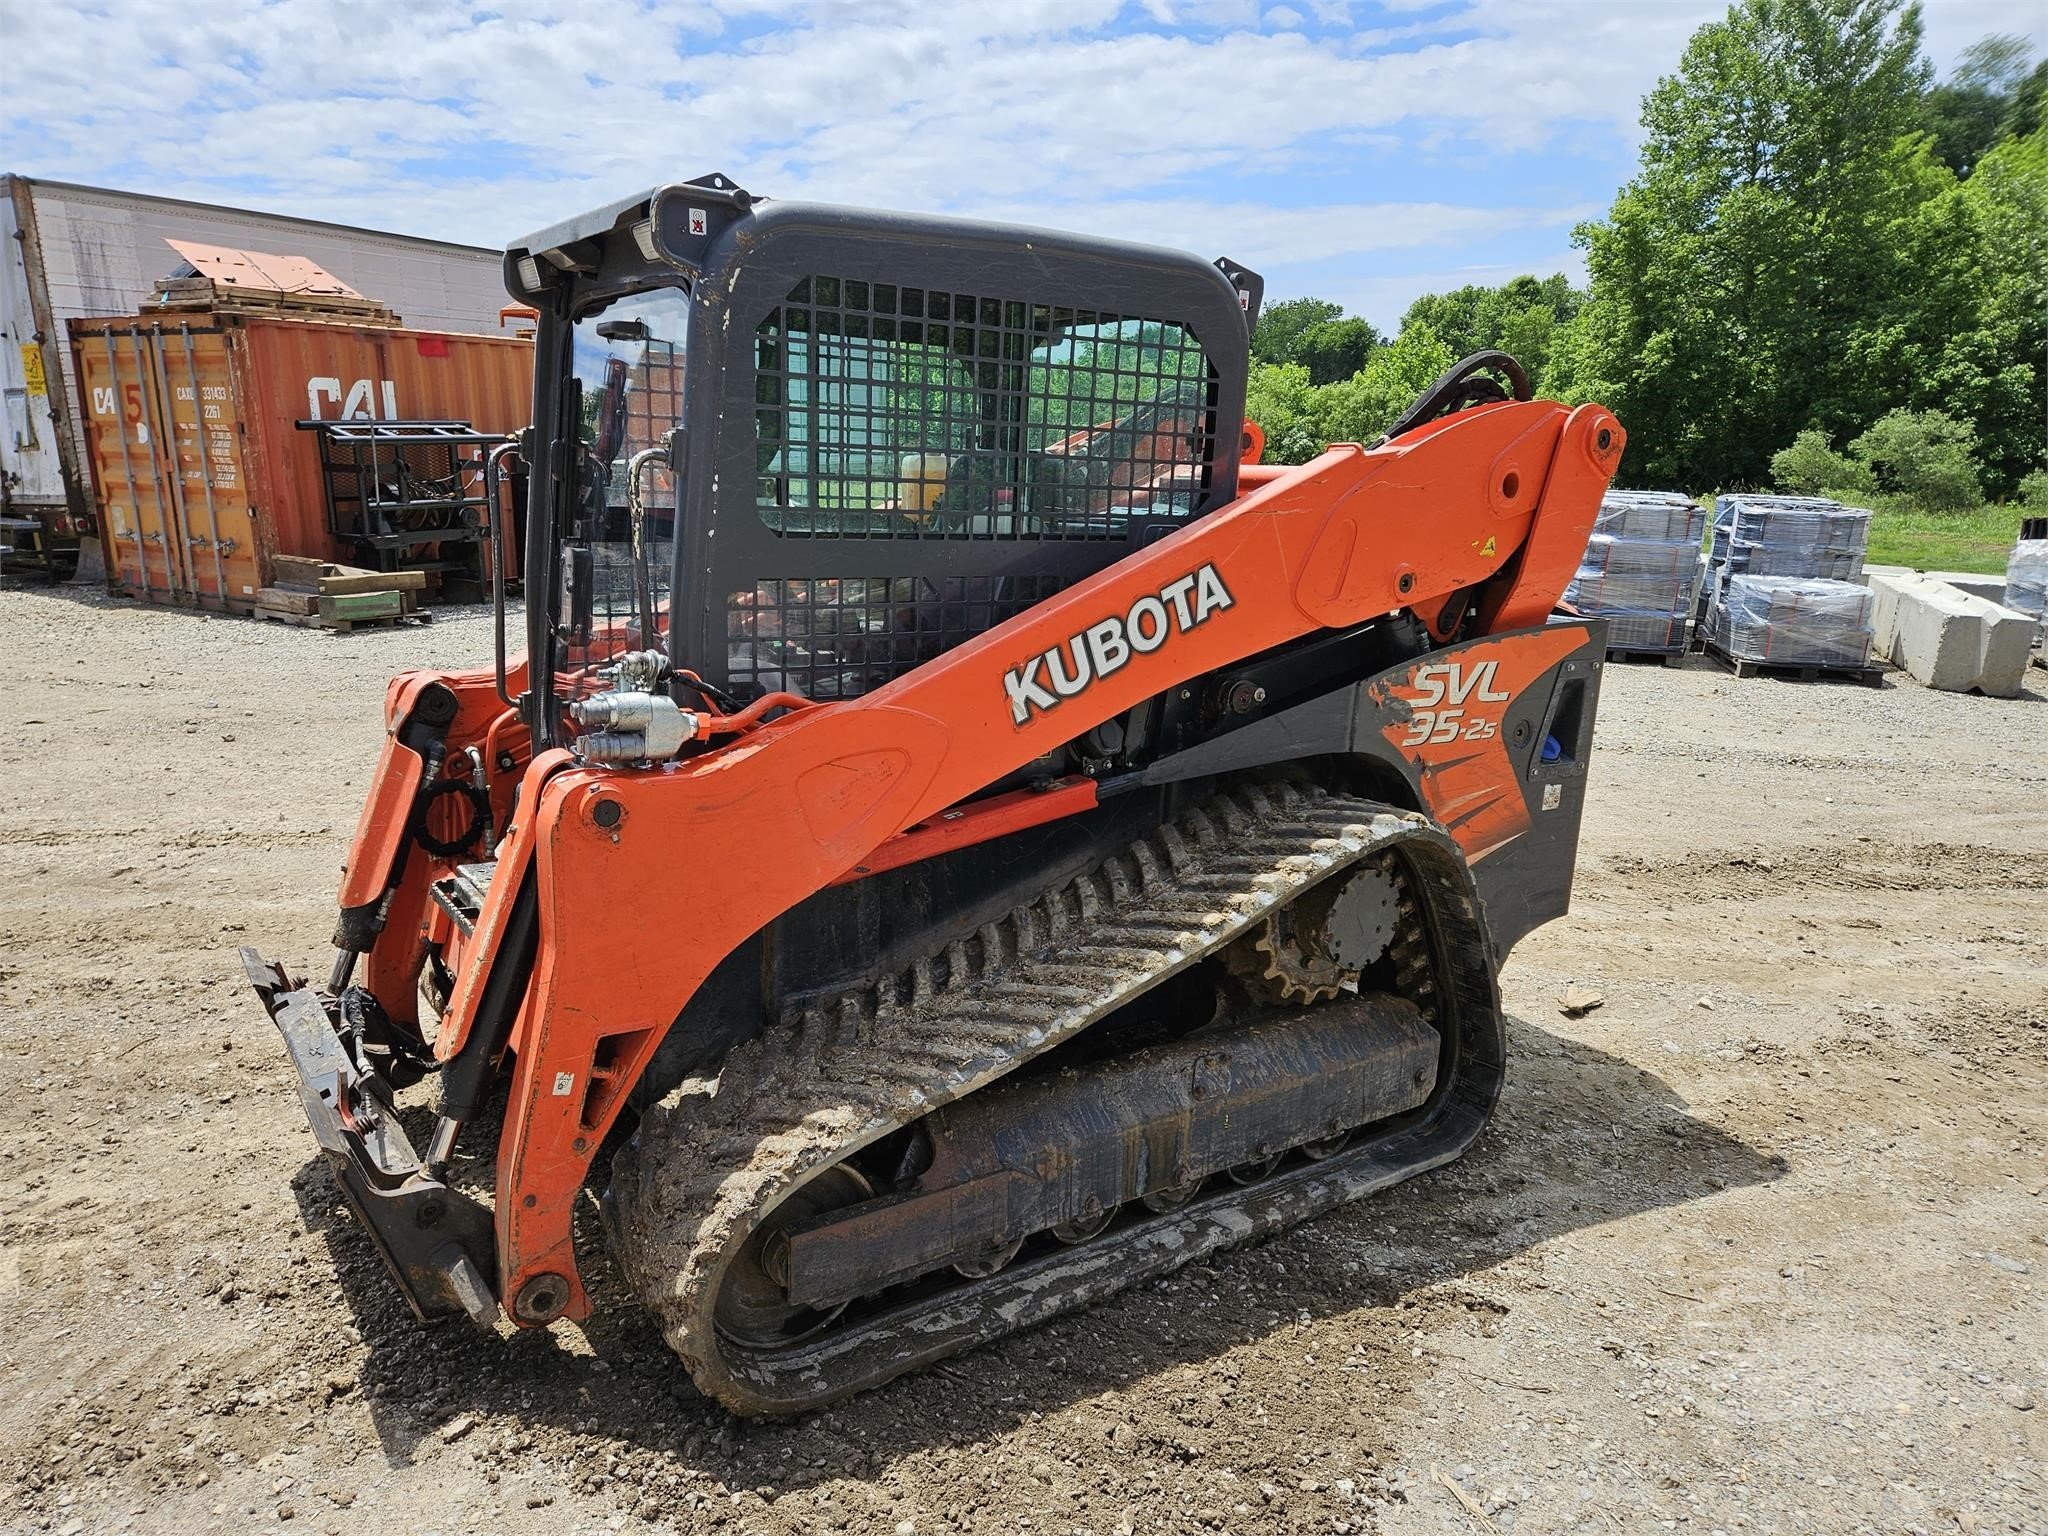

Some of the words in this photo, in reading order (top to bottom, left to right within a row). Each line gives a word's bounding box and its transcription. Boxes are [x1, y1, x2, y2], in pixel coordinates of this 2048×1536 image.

[125, 385, 142, 422] 5
[1003, 562, 1235, 726] KUBOTA
[1406, 661, 1511, 708] SVL
